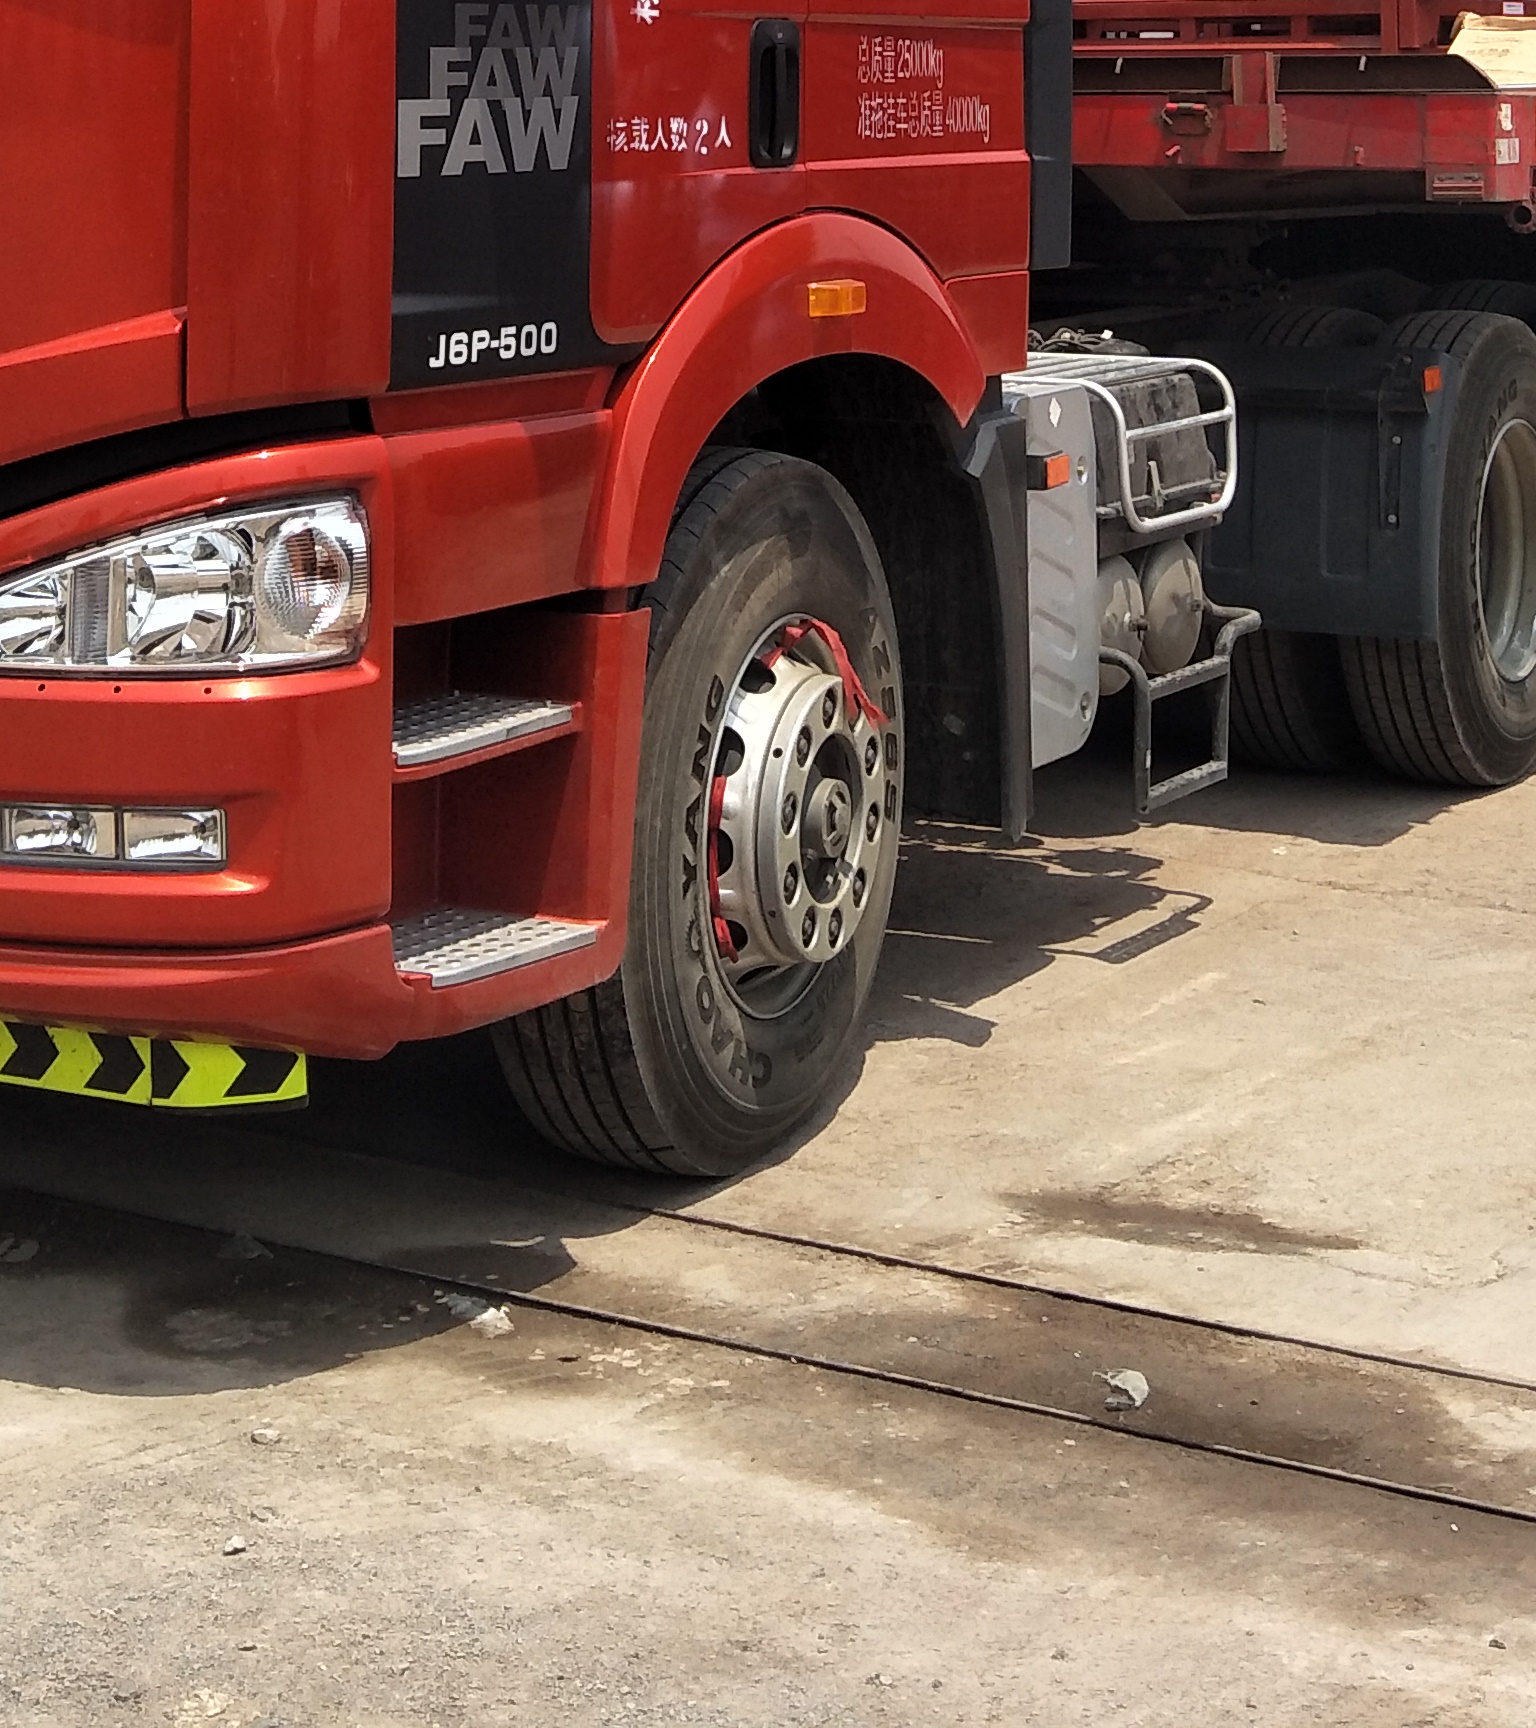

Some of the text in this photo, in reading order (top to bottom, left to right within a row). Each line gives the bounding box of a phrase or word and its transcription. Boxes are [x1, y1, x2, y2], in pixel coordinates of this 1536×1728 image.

[454, 3, 580, 58] FAW
[430, 46, 580, 110] FAW
[397, 96, 580, 178] FAW
[428, 321, 558, 369] J6P-500
[682, 673, 773, 1090] CHAO YANG
